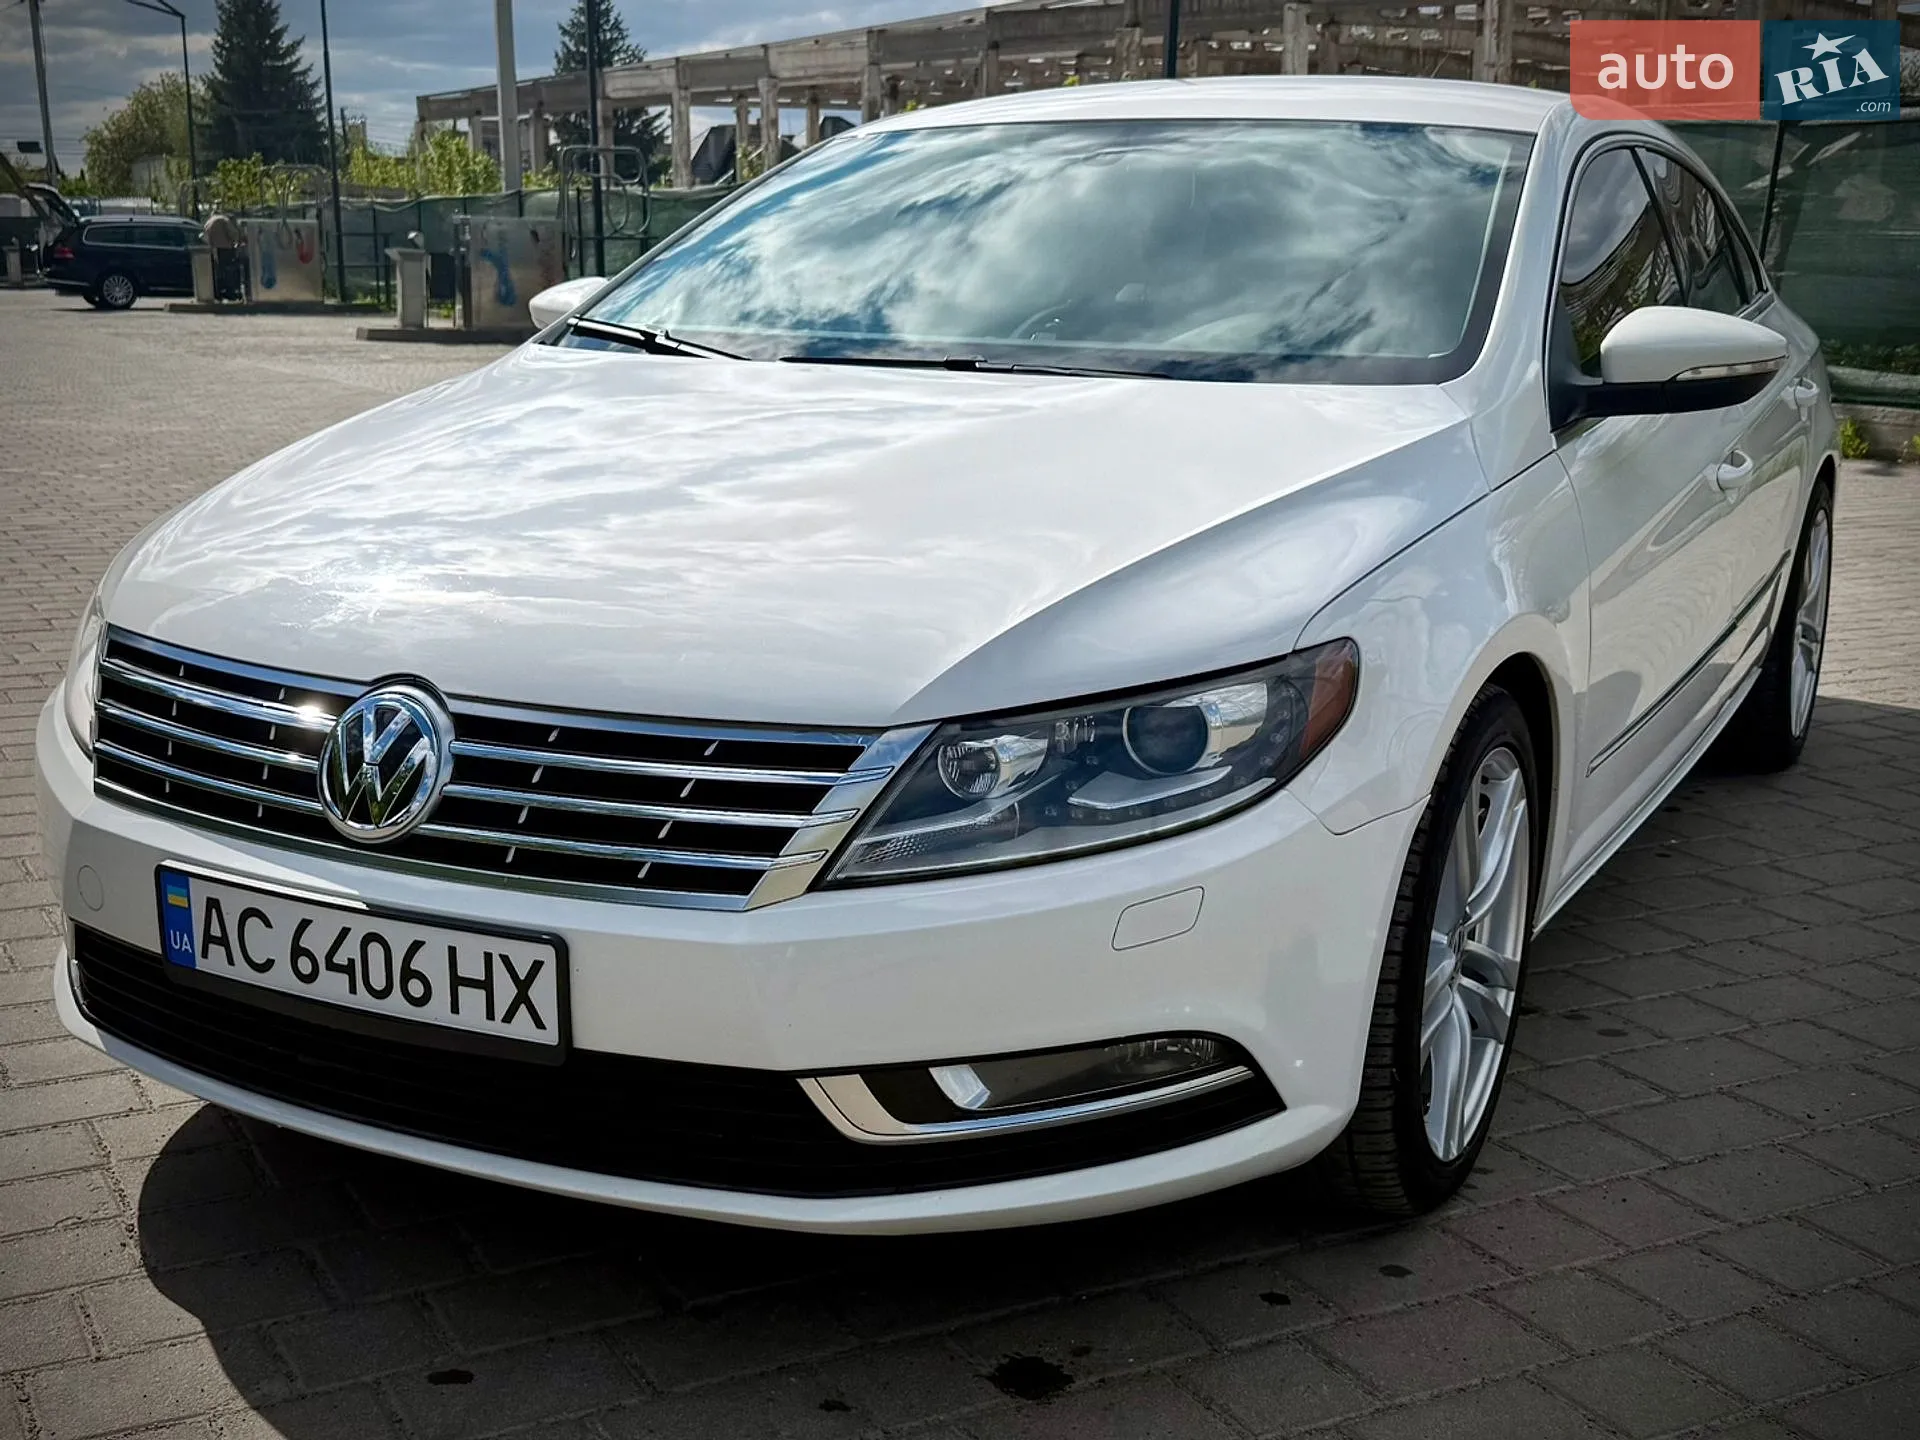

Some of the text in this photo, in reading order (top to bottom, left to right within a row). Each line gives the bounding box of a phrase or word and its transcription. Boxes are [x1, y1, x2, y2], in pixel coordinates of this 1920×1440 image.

[170, 929, 192, 954] UA
[201, 896, 547, 1030] AC 6406 HX
